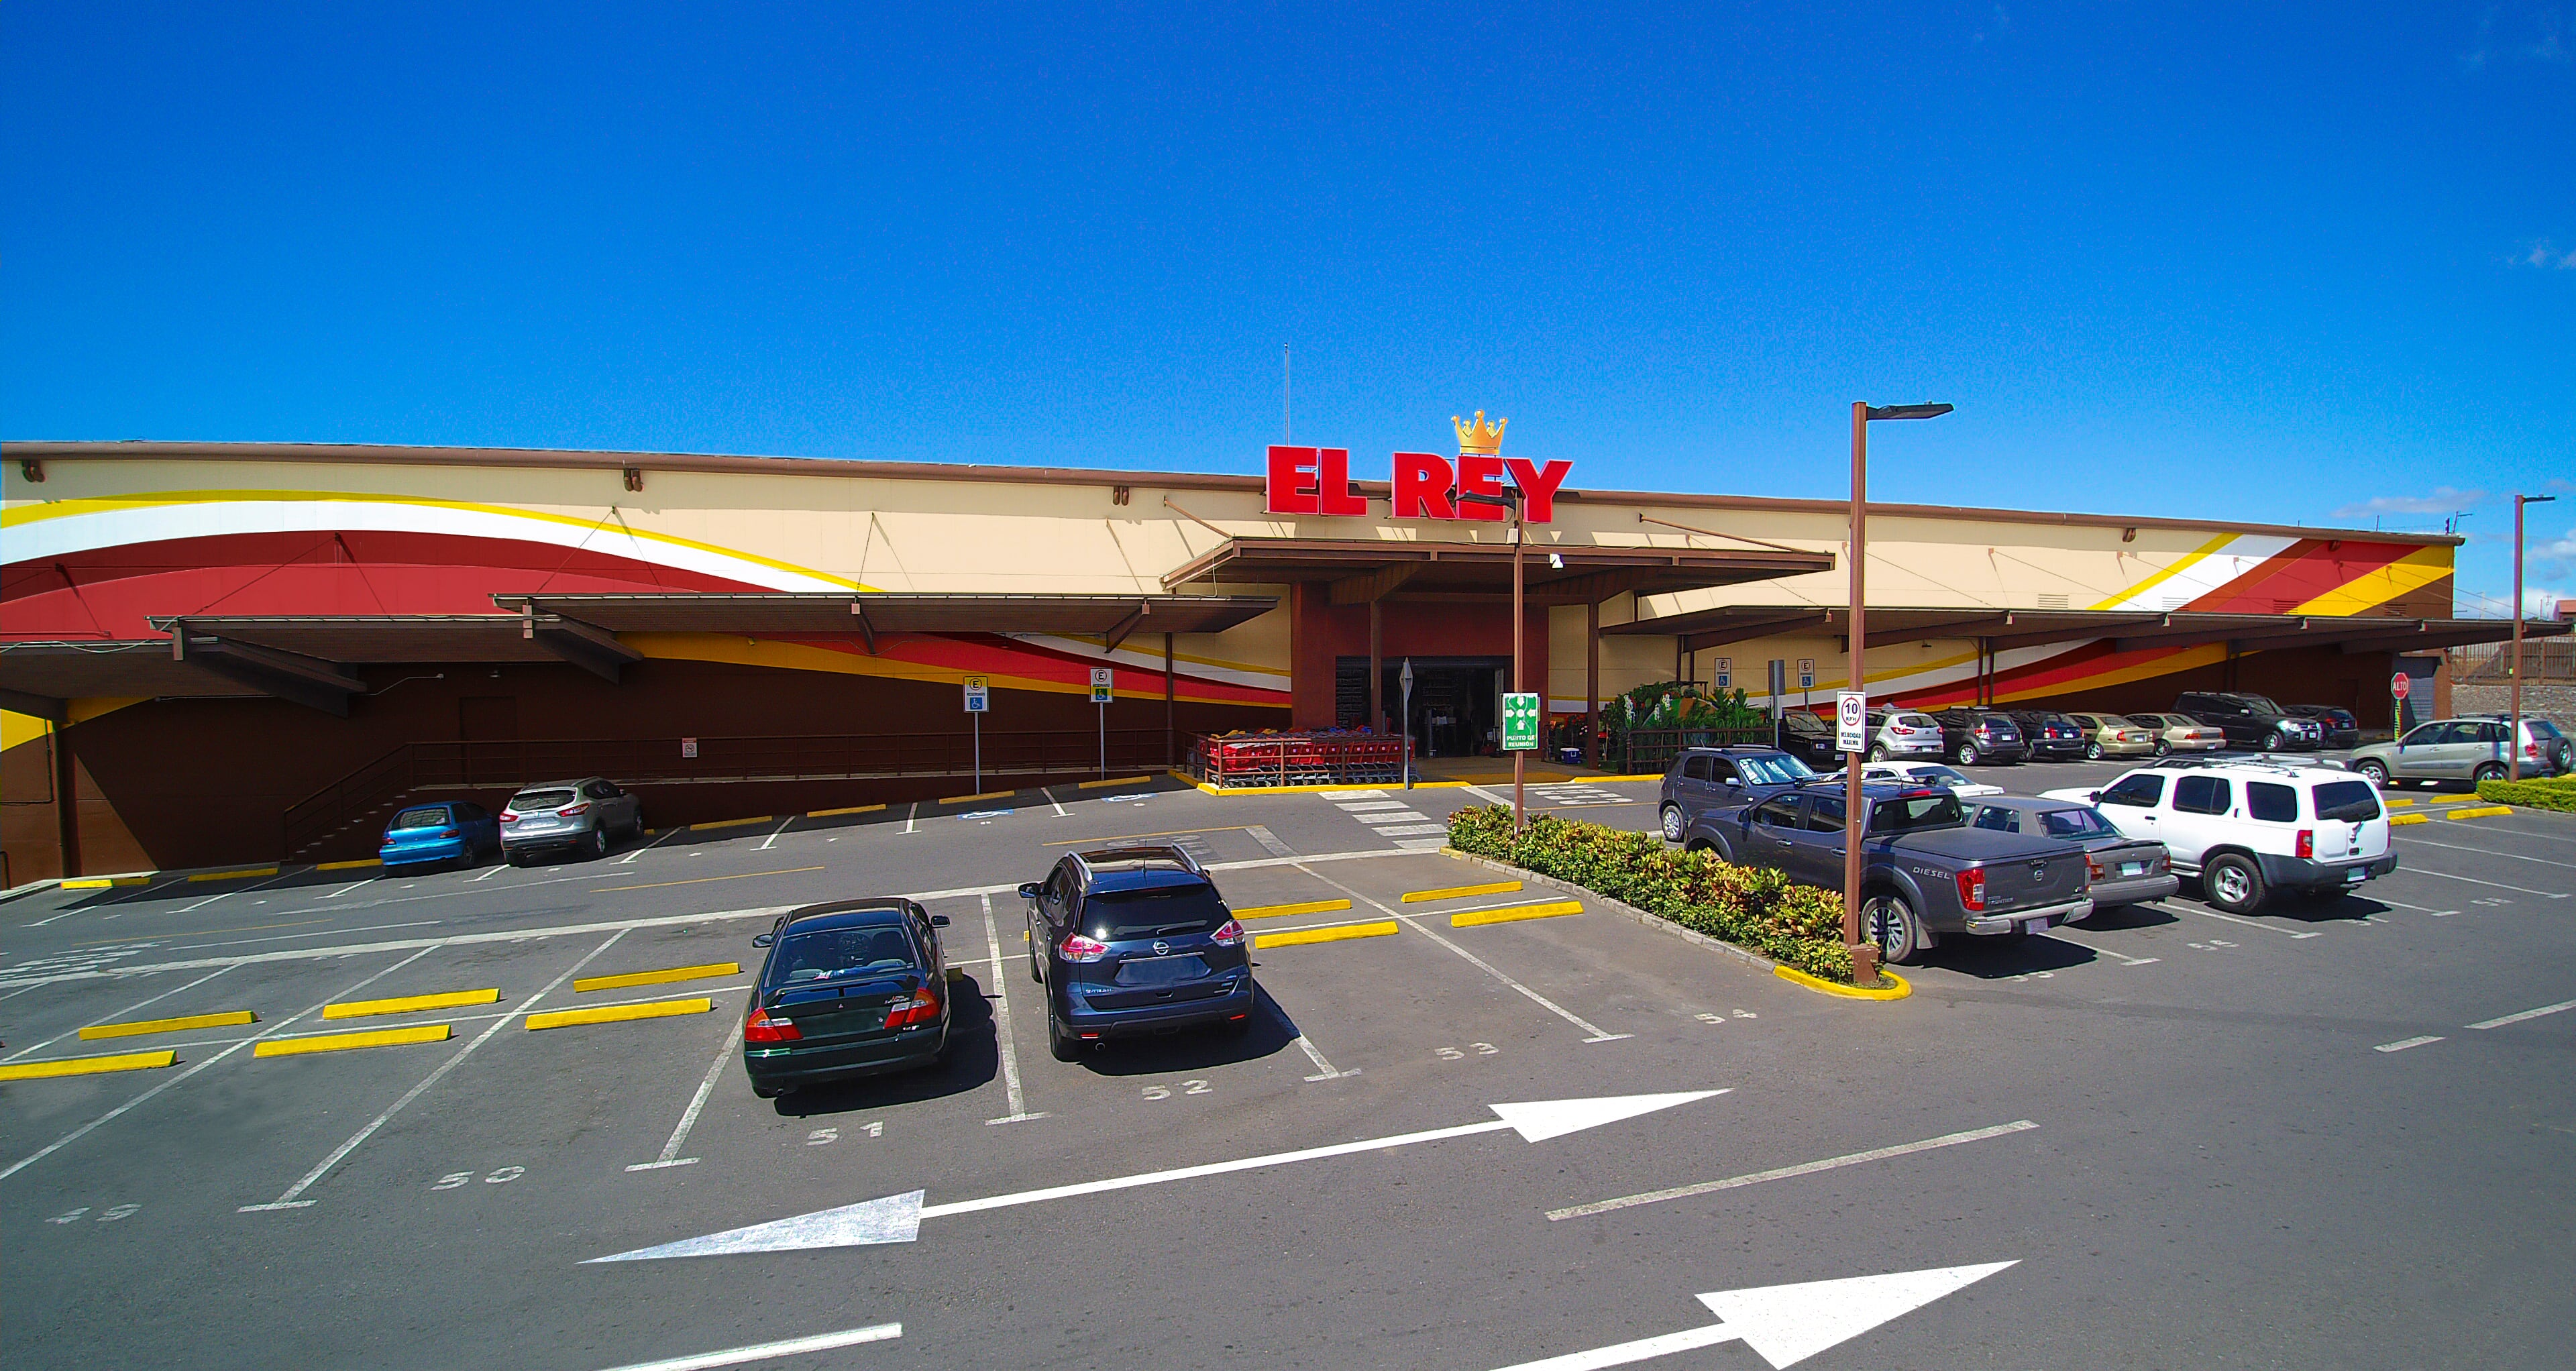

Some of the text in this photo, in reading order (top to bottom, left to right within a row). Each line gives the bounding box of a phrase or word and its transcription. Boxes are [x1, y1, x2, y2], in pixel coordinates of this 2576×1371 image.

[1266, 445, 1574, 523] EL REY
[973, 680, 979, 688] E
[2393, 681, 2407, 691] ALTO
[1845, 703, 1858, 714] 10
[1913, 867, 1950, 880] DIESEL
[1434, 1042, 1499, 1060] 53
[1142, 1079, 1213, 1100] 52
[806, 1121, 883, 1146] 51
[429, 1166, 526, 1190] 50
